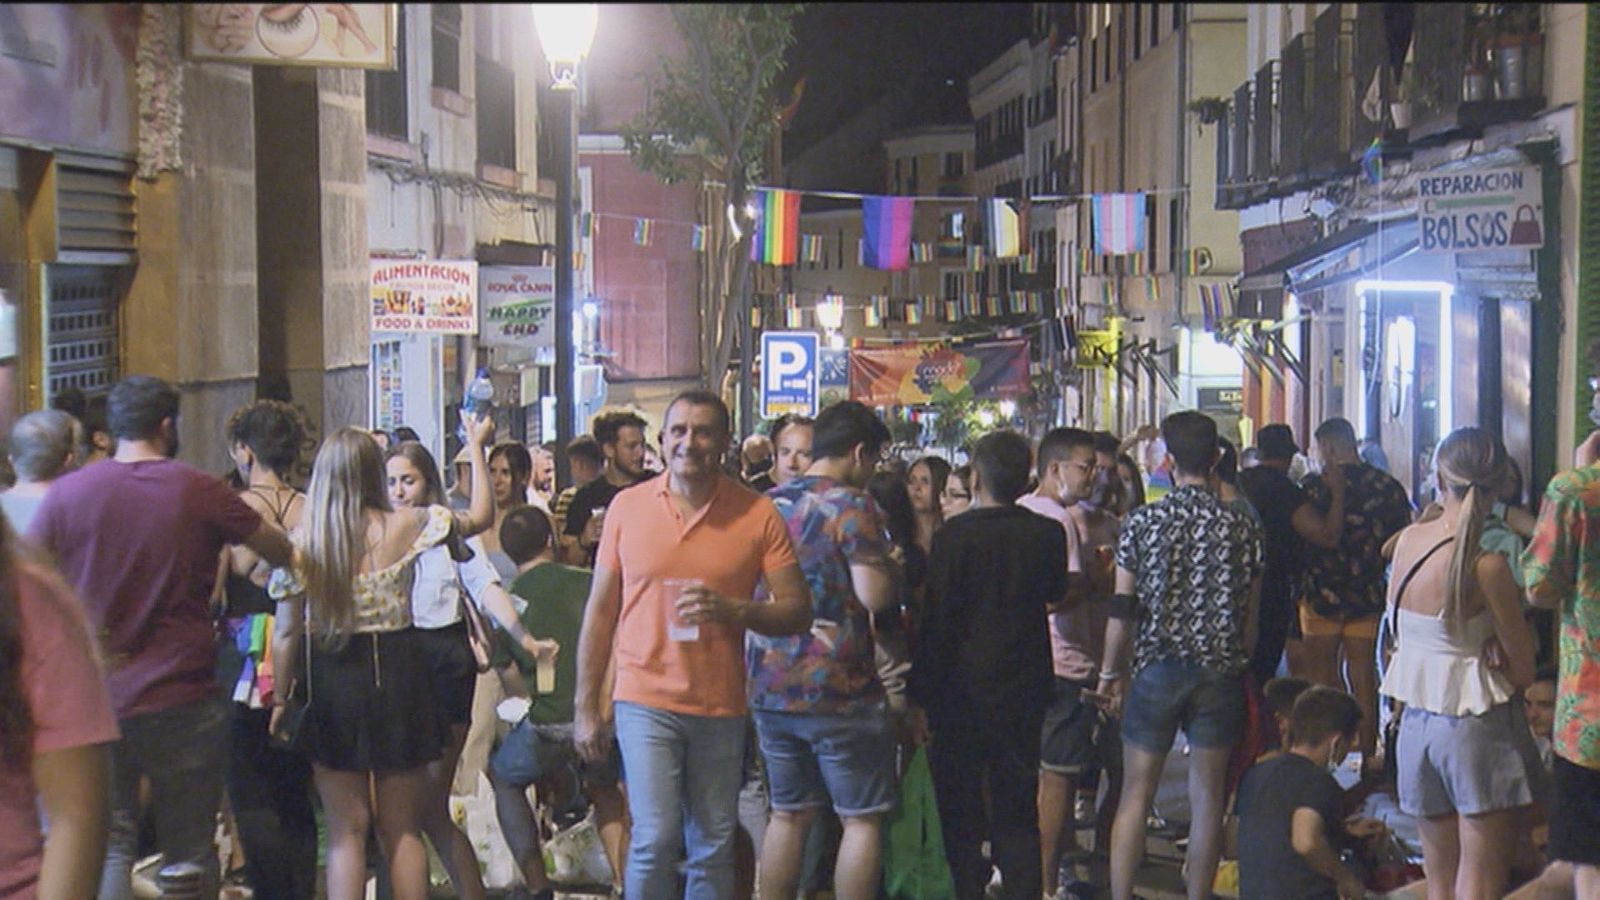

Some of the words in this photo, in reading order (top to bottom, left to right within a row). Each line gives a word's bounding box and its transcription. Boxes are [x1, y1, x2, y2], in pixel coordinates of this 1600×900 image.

[1420, 171, 1523, 196] REPARACION
[1422, 211, 1508, 250] BOLSOS
[373, 264, 470, 286] ALIMENTACION
[487, 283, 517, 293] ROYAL
[490, 306, 552, 319] HAPPY
[375, 318, 411, 329] FOOD
[415, 319, 424, 329] &
[427, 317, 470, 329] DRINKS
[503, 323, 539, 335] END
[768, 341, 807, 391] P
